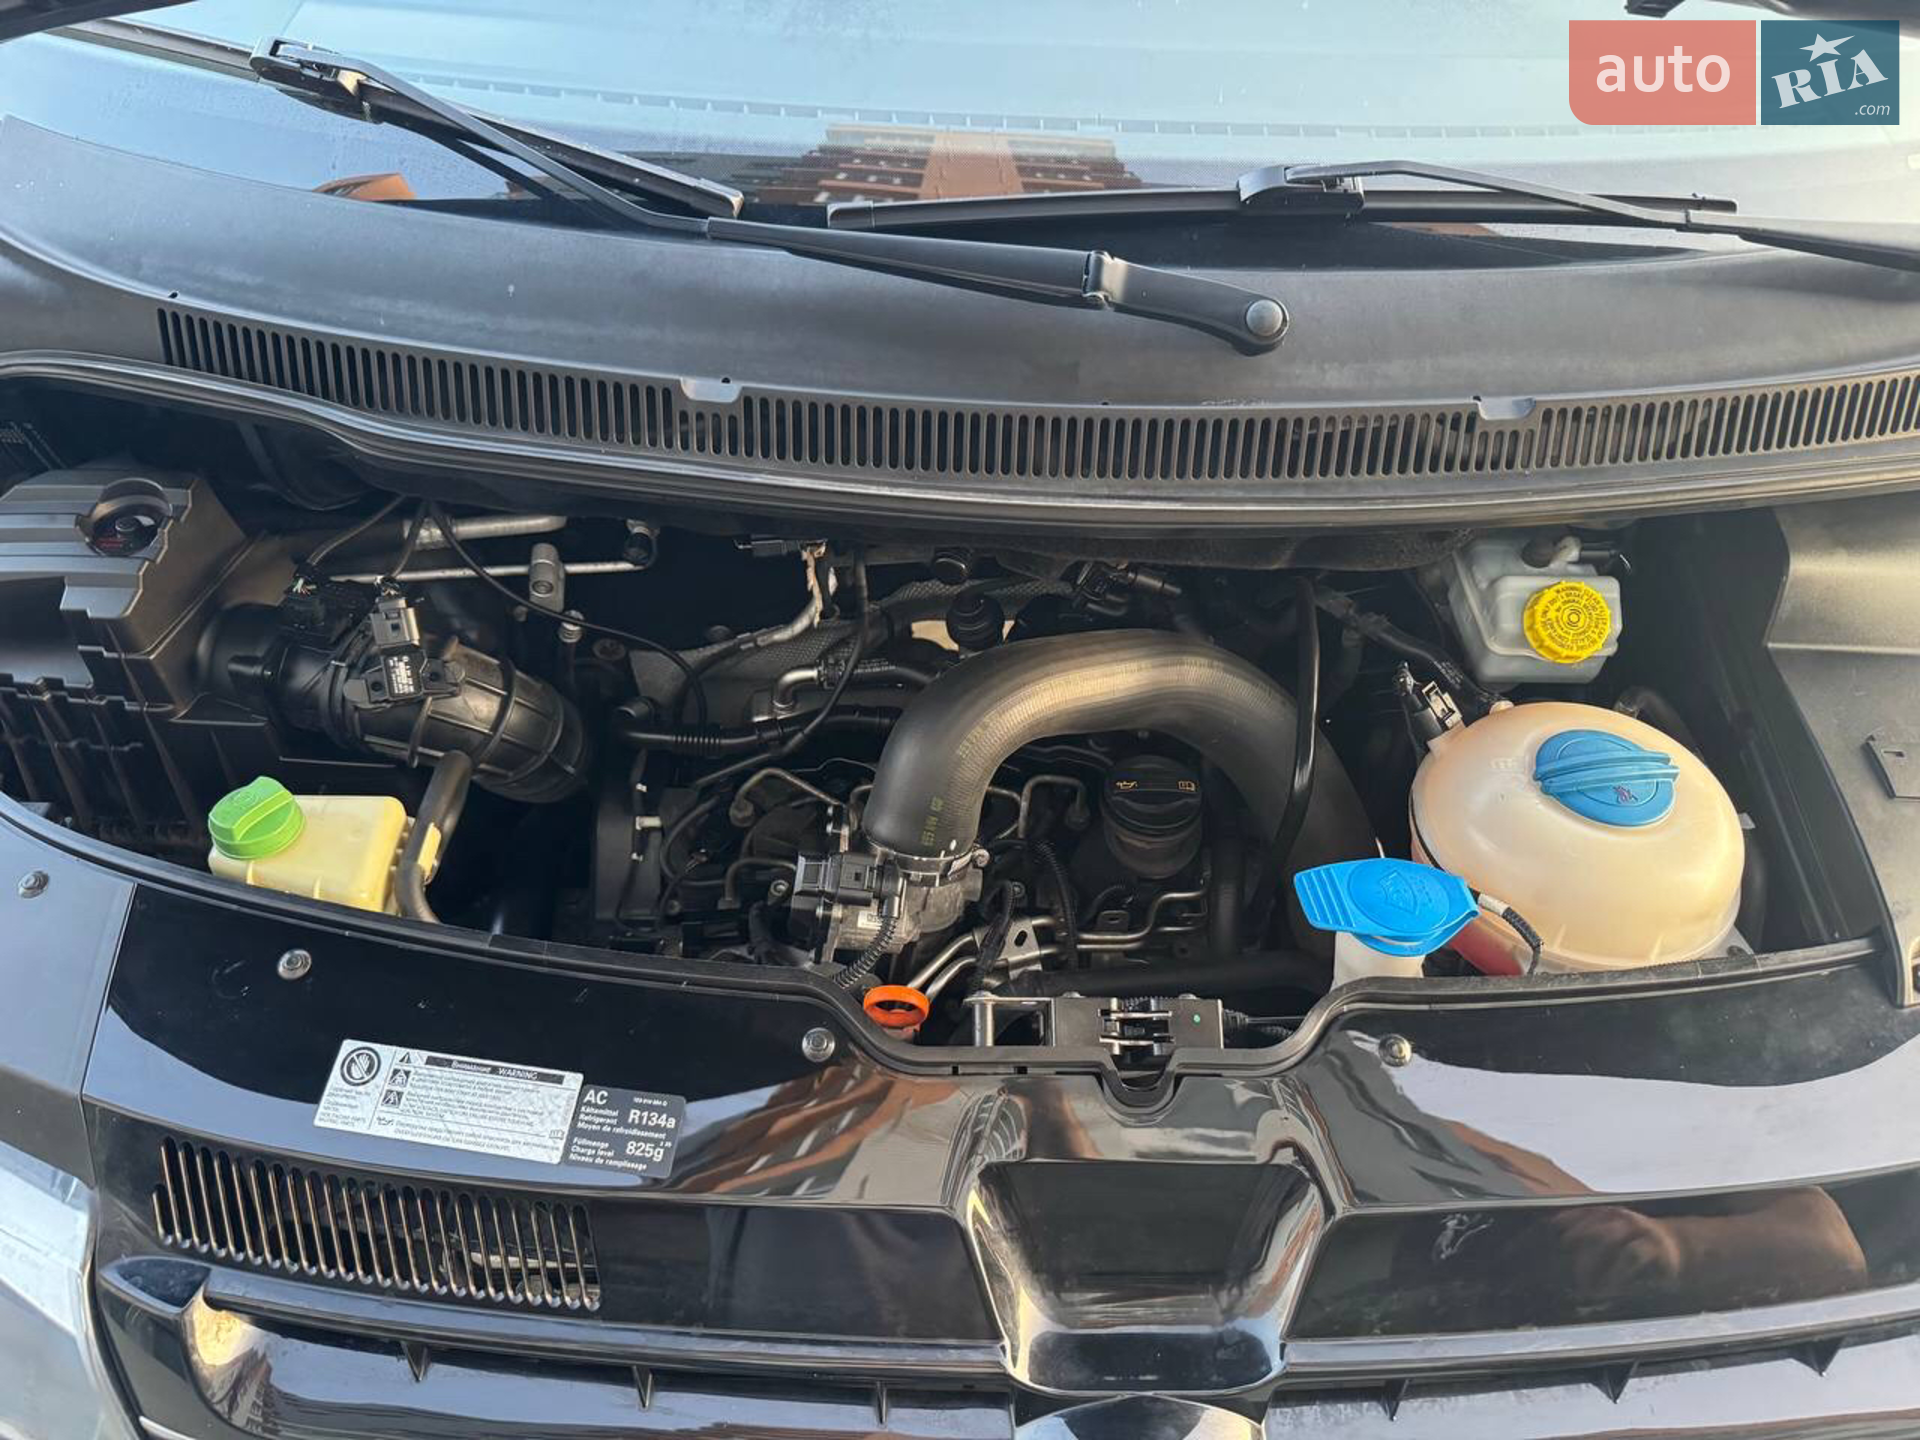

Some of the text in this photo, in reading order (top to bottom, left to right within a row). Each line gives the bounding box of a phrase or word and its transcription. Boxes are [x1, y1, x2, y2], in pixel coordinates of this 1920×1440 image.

[499, 1067, 538, 1081] WARNING
[583, 1089, 609, 1105] AC
[628, 1109, 676, 1129] R134a
[626, 1141, 665, 1162] 825g
